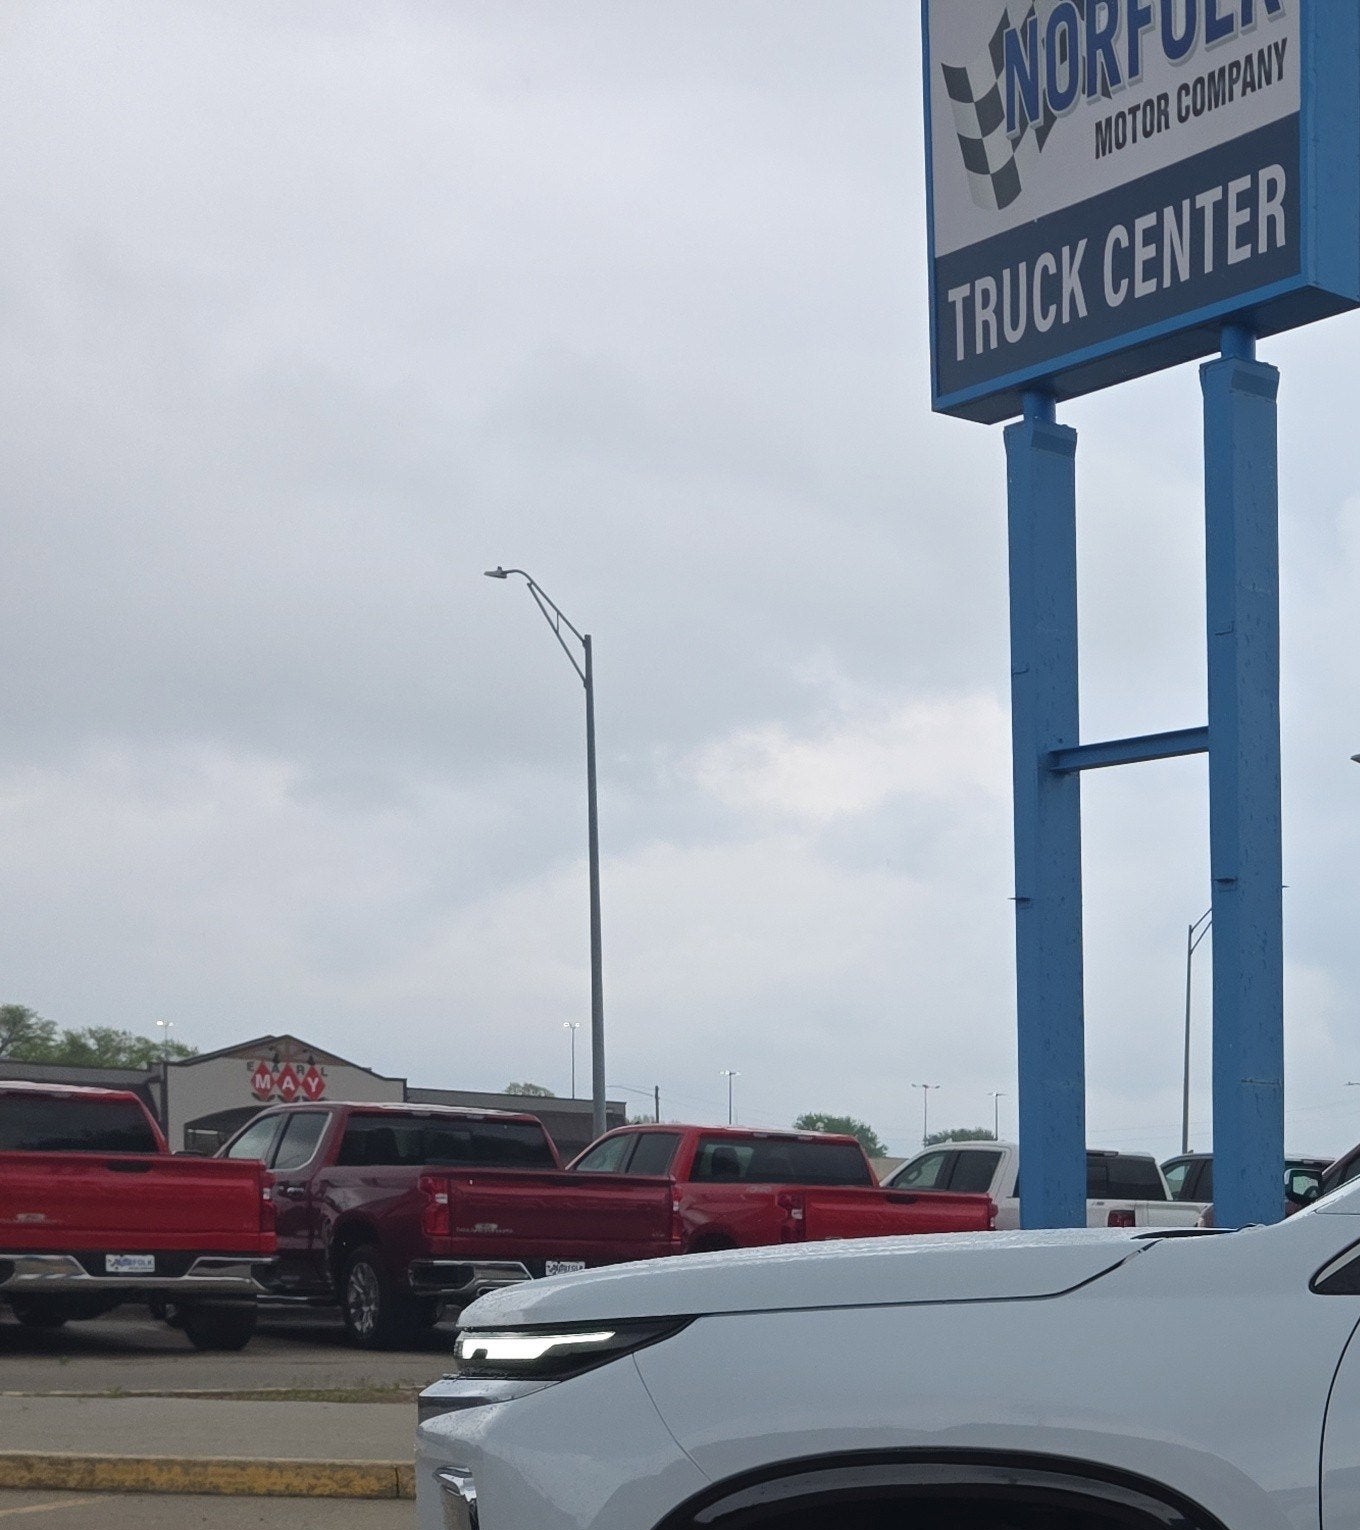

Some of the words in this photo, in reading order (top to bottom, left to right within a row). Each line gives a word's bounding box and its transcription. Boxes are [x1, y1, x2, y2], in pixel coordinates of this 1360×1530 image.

[1004, 0, 1284, 136] NORF
[1094, 92, 1171, 159] MOTOR
[1176, 37, 1288, 124] COMPANY
[947, 237, 1088, 361] TRUCK
[1103, 163, 1287, 308] CENTER
[255, 1074, 319, 1092] MAY
